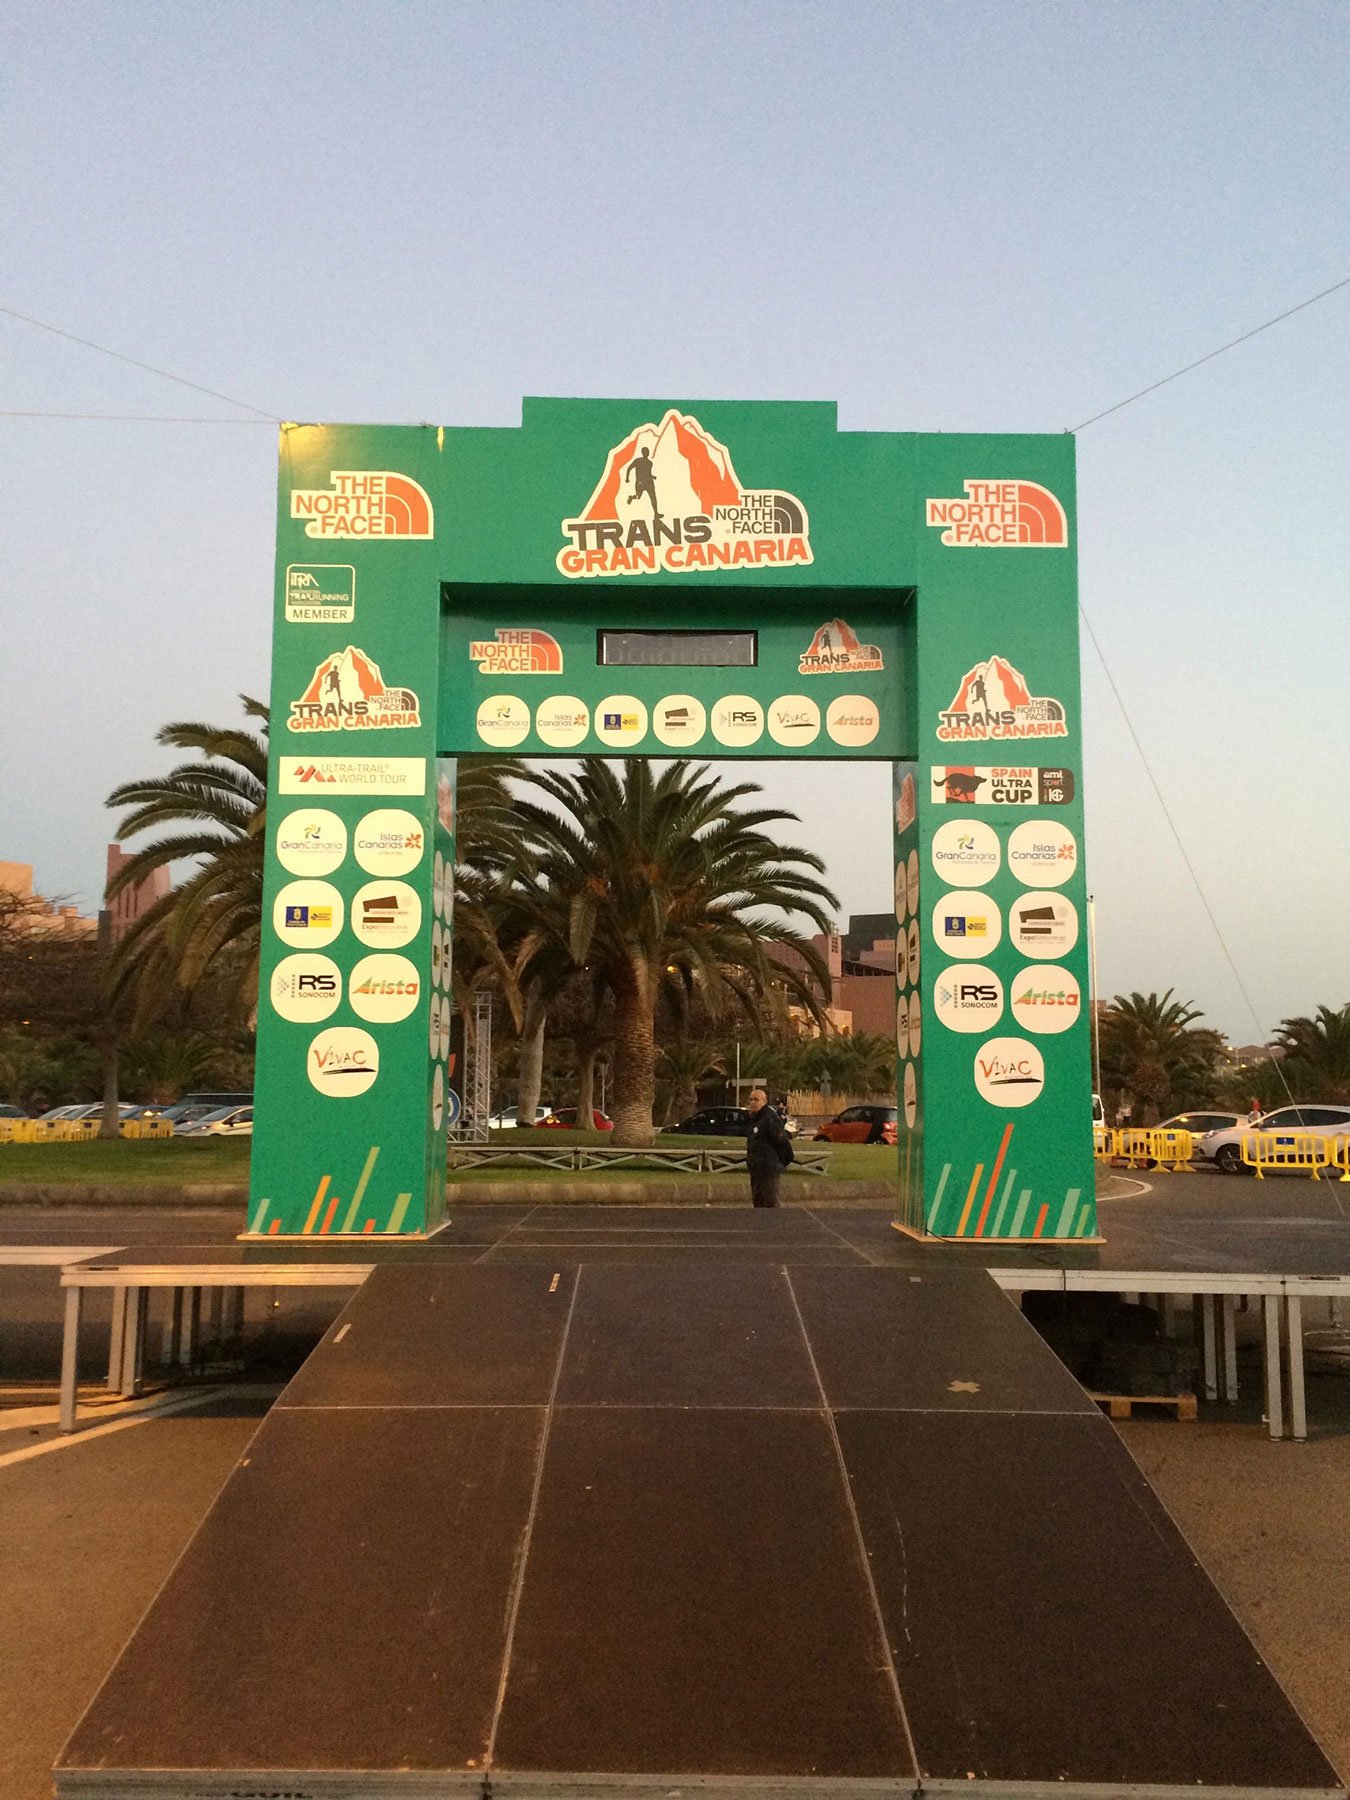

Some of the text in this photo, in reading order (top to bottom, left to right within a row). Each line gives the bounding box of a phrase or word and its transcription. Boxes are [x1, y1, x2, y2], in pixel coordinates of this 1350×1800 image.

[336, 475, 383, 494] THE
[968, 484, 1016, 503] THE
[295, 495, 383, 514] NORTH
[740, 495, 772, 508] THE
[715, 508, 773, 521] NORTH
[930, 503, 1017, 523] NORTH
[321, 515, 383, 535] FACE
[732, 521, 773, 534] FACE
[567, 515, 712, 551] TRANS
[956, 523, 1017, 543] FACE
[562, 537, 808, 572] GRAN CANARIA
[292, 609, 348, 619] MEMBER
[498, 631, 529, 644] THE
[472, 644, 530, 658] NORTH
[489, 658, 530, 671] FACE
[802, 653, 850, 665] TRANS
[800, 660, 882, 673] GRAN CANARIA
[293, 701, 369, 718] TRANS
[1017, 706, 1047, 714] NORTH
[290, 713, 418, 730] GRAN CANARIA
[477, 719, 529, 727] GranCanaria
[537, 719, 572, 727] Canarias
[732, 711, 757, 722] RS
[832, 714, 873, 726] Arista
[941, 710, 1016, 727] TRANS
[938, 722, 1066, 739] GRAN CANARIA
[338, 774, 407, 784] WORLD TOUR
[991, 768, 1032, 778] SPAIN
[991, 779, 1032, 788] ULTRA
[991, 789, 1032, 804] CUP
[380, 833, 403, 841] Islas
[280, 841, 343, 850] GranCanaria
[358, 841, 403, 849] Canarias
[1033, 843, 1056, 852] Islas
[935, 851, 997, 861] GranCanaria
[1011, 851, 1056, 860] Canarias
[298, 975, 336, 990] RS
[352, 976, 418, 996] Arista
[960, 984, 998, 1001] RS
[1013, 987, 1079, 1006] Arista
